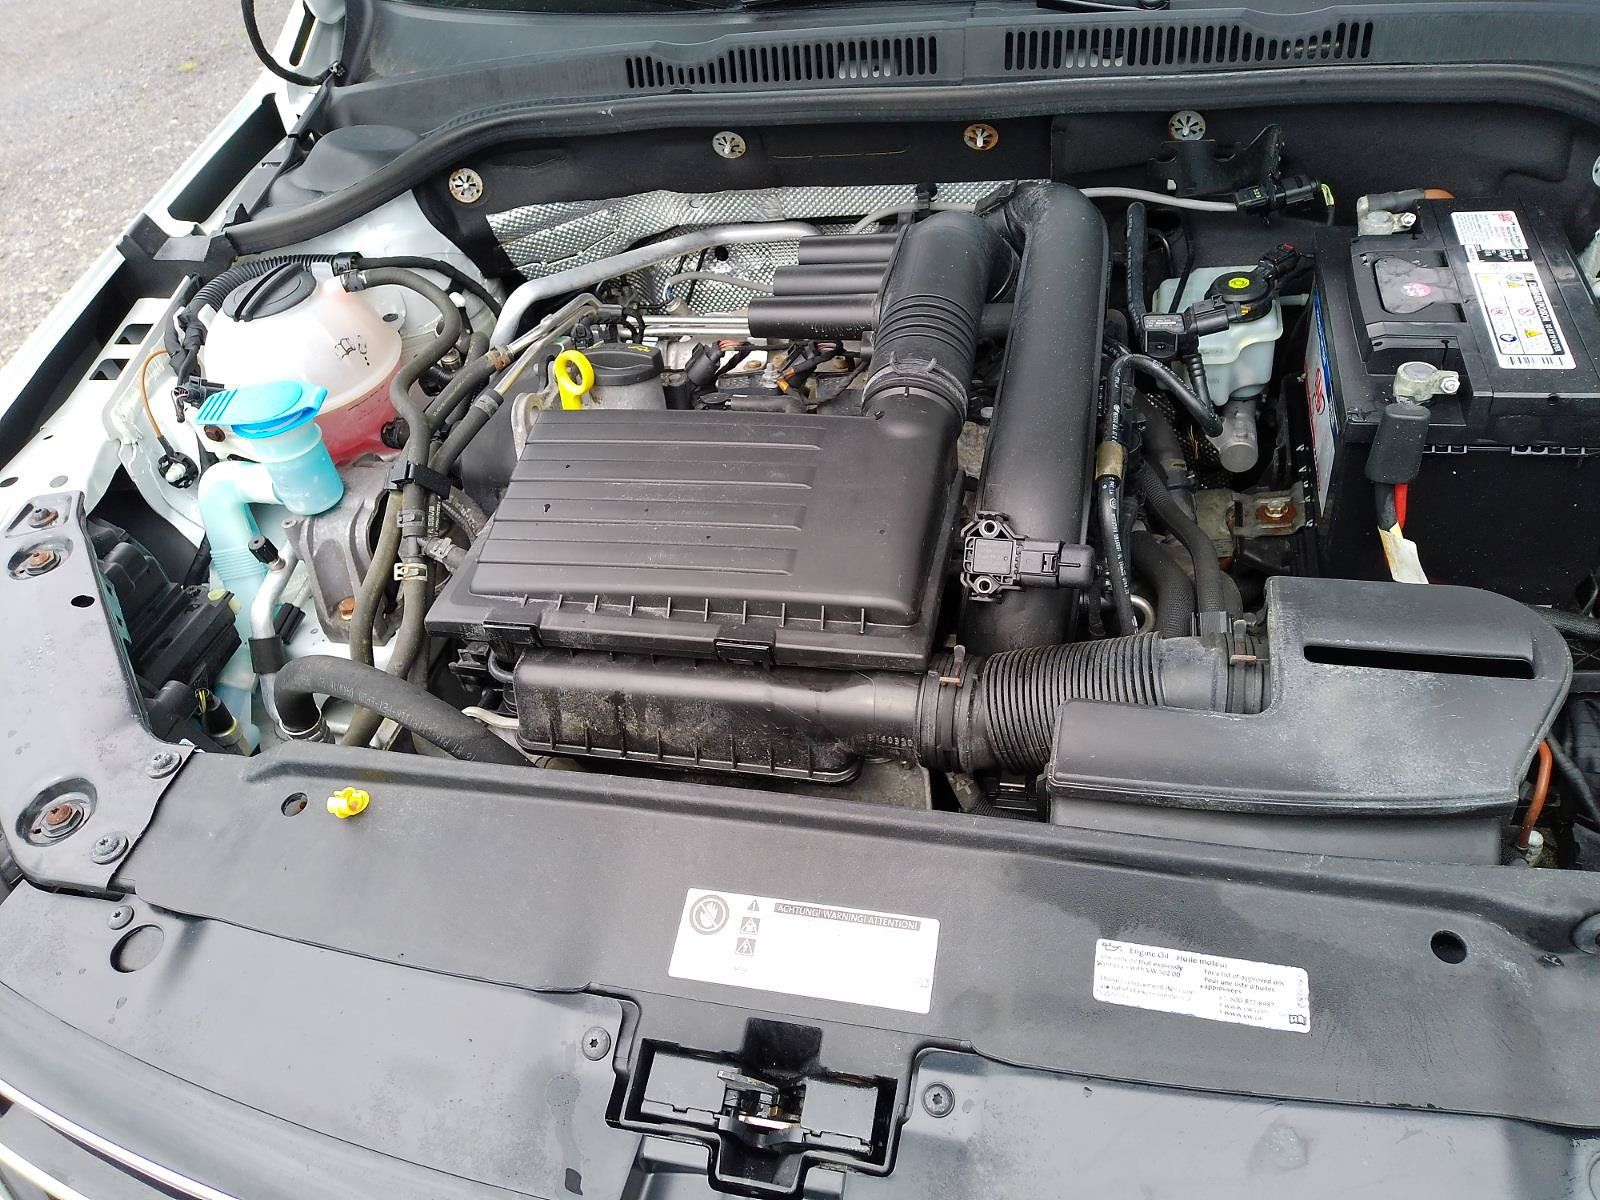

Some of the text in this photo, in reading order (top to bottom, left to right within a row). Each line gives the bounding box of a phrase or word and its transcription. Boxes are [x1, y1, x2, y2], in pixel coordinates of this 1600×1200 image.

[1129, 947, 1228, 969] Engine Oil Huile moteur
